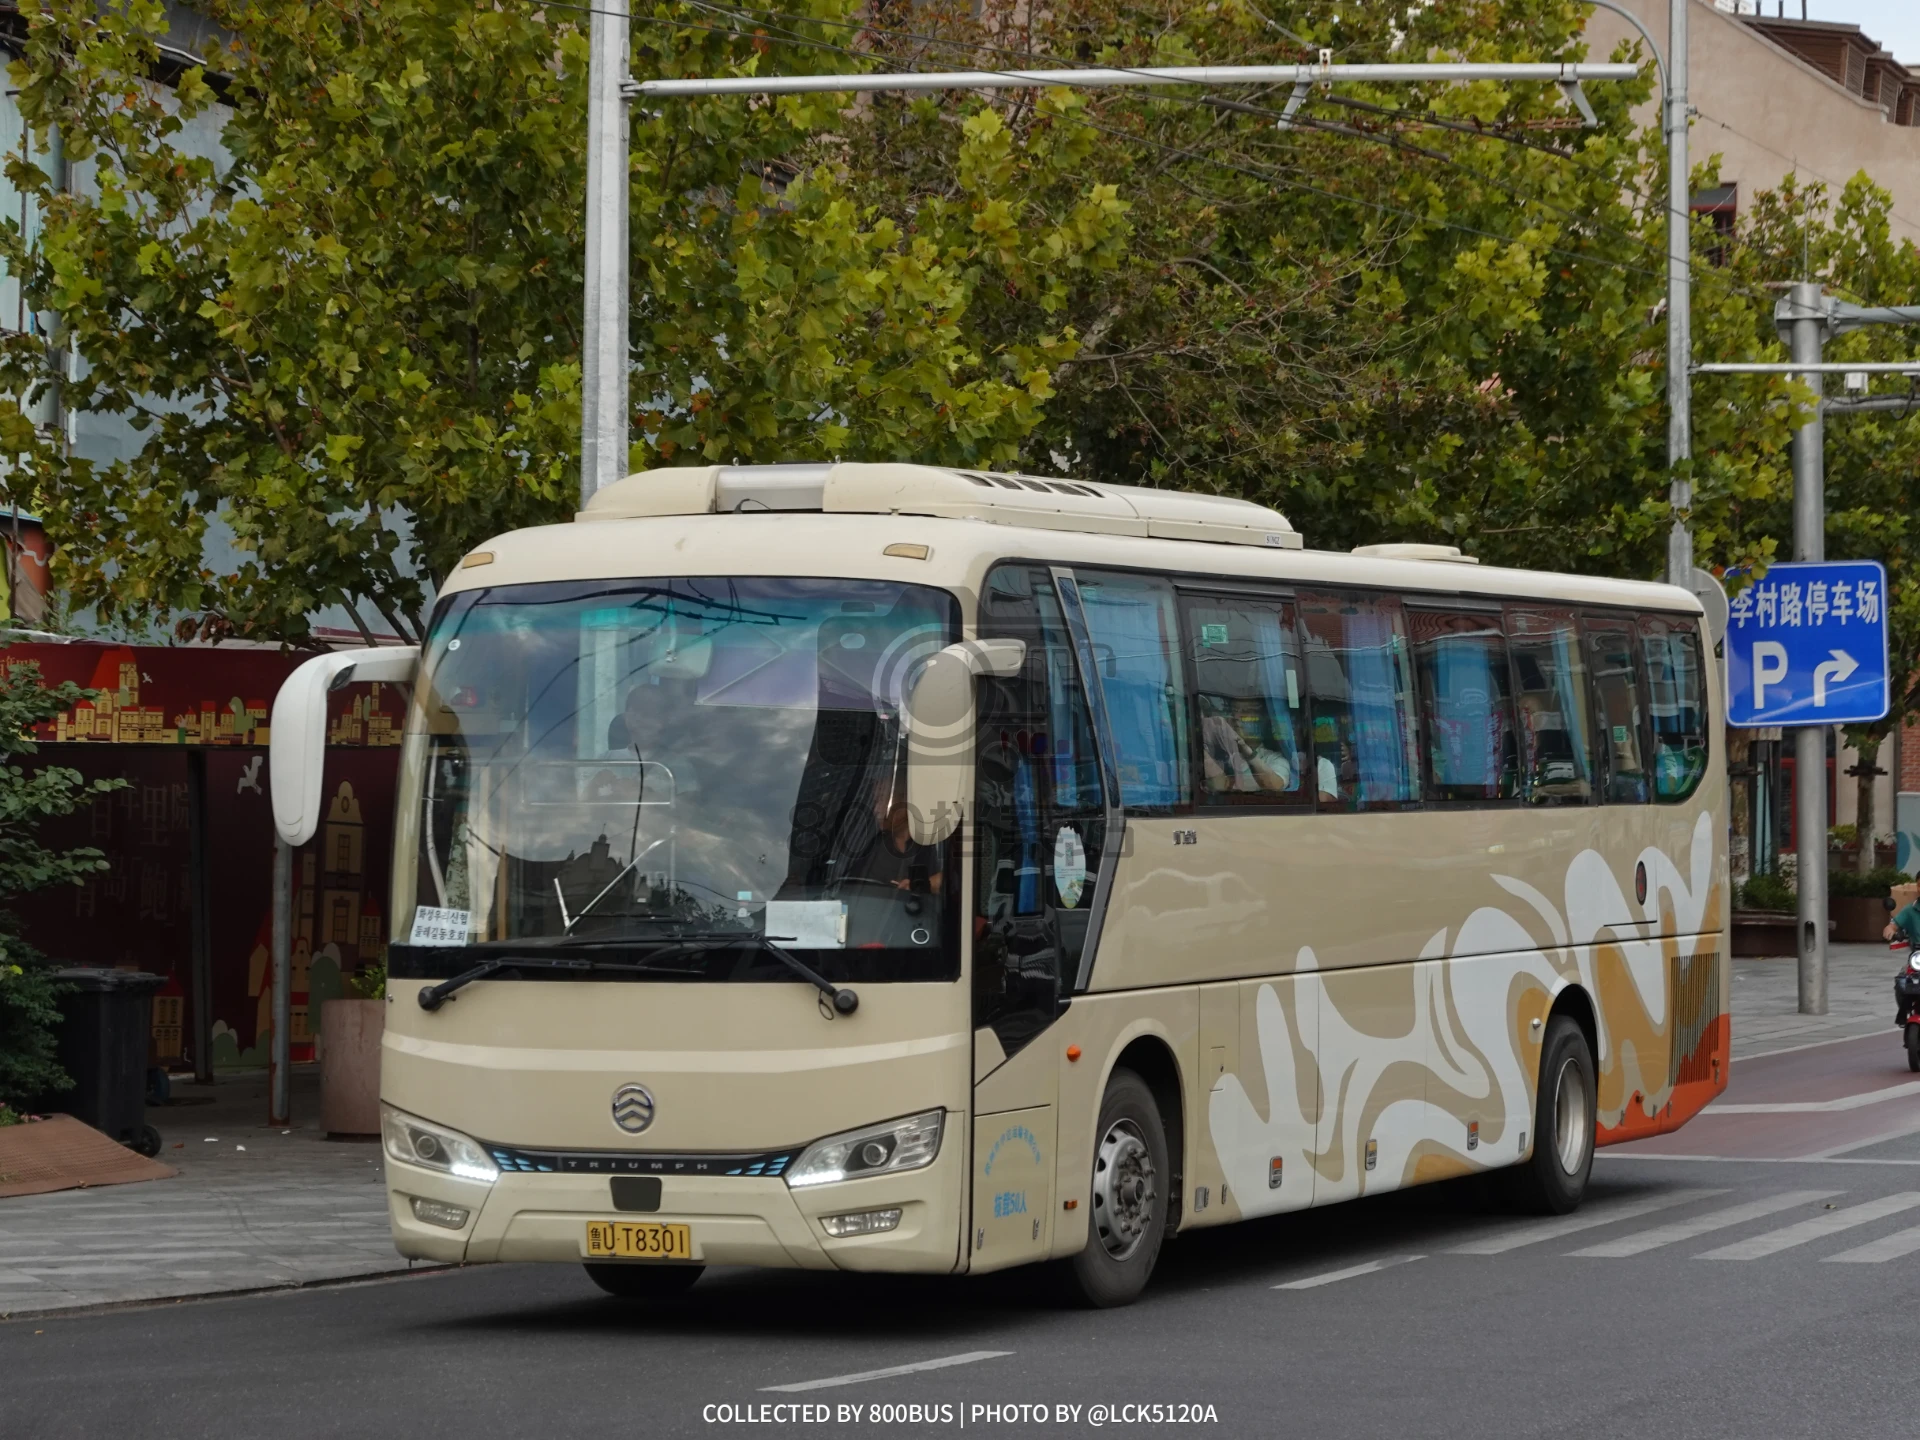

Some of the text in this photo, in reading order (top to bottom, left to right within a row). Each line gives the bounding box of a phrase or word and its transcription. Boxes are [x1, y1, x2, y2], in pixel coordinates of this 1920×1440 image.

[1730, 580, 1879, 628] 李村路停车场
[1752, 641, 1789, 710] P
[567, 1160, 708, 1171] TRIUMPH
